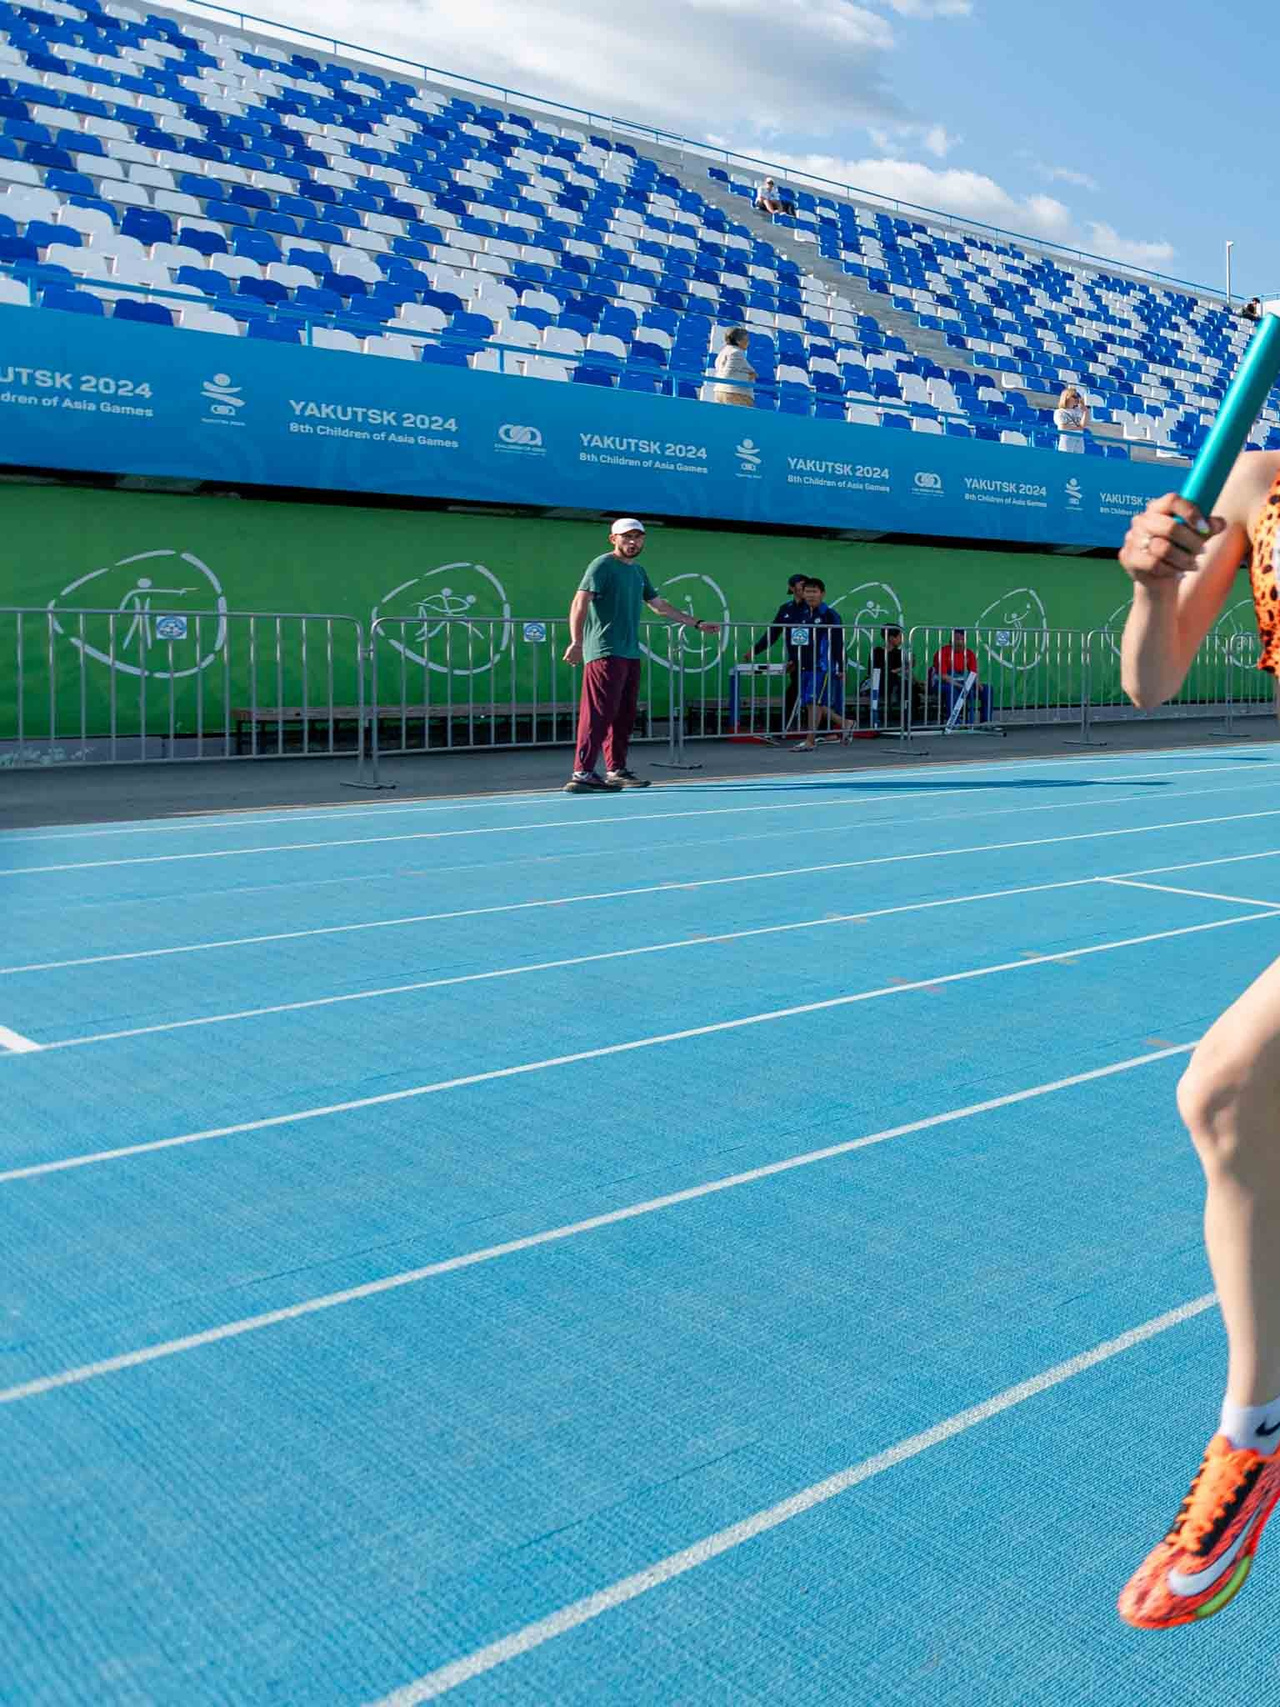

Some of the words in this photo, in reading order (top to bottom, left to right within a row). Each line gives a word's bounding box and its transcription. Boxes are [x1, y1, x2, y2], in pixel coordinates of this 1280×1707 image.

[80, 375, 152, 398] 2024
[0, 391, 38, 405] dren
[42, 396, 59, 407] of
[62, 398, 96, 411] Asia
[100, 401, 154, 417] Games
[289, 400, 398, 426] YAKUTSK
[402, 413, 459, 432] 2024
[289, 422, 314, 434] 8th
[317, 425, 370, 440] Children
[372, 432, 387, 441] of
[388, 433, 415, 444] Asia
[417, 436, 459, 448] Games
[580, 433, 661, 454] YAKUTSK
[664, 443, 707, 459] 2024
[580, 452, 598, 462] 8th
[600, 454, 641, 467] Children
[642, 459, 653, 468] of
[654, 460, 675, 470] Asia
[676, 463, 708, 474] Games
[787, 457, 853, 476] YAKUTSK
[855, 465, 889, 480] 2024
[803, 476, 837, 487] Children
[837, 480, 846, 488] of
[964, 478, 1017, 493] YAKUTSK
[1019, 483, 1047, 497] 2024
[1100, 491, 1144, 506] YAKUTSK
